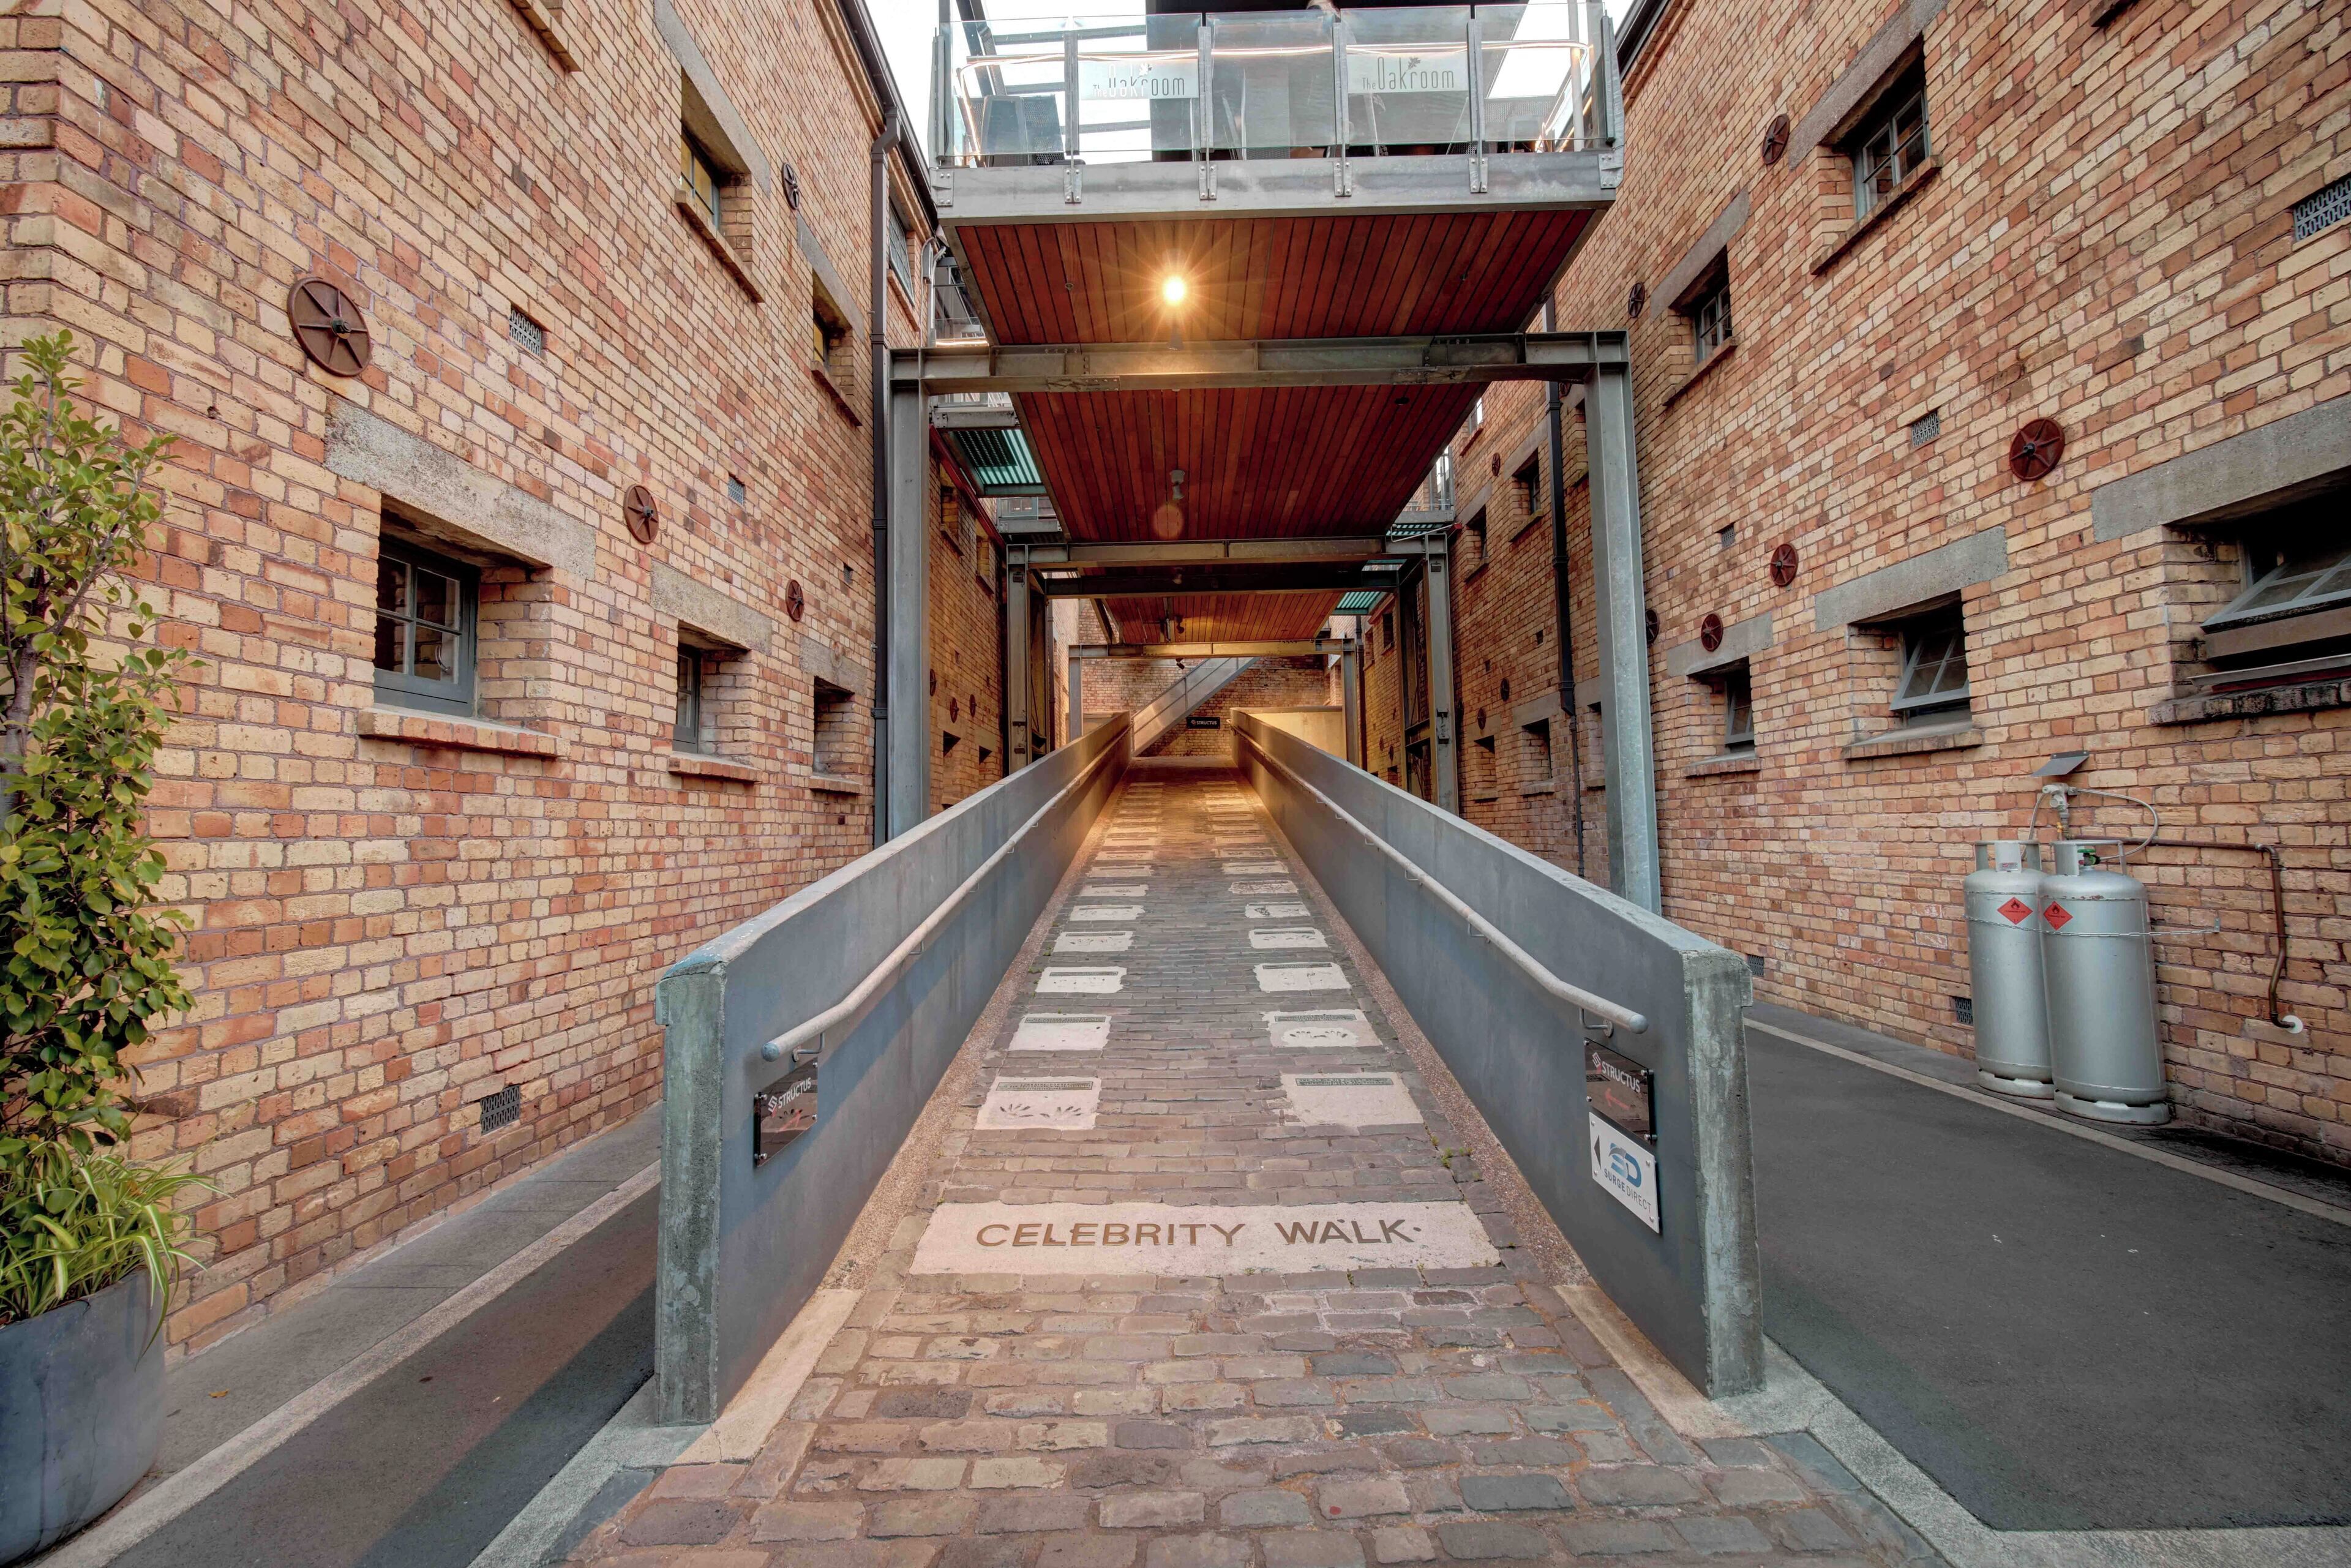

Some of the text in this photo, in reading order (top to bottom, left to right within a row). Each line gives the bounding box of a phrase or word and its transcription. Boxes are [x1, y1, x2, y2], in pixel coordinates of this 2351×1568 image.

[1109, 64, 1184, 97] Oakroom
[1362, 56, 1454, 90] The Oakroom
[778, 1077, 812, 1109] STRUCTUS
[1602, 1061, 1641, 1093] STRUCTUS
[977, 1219, 1415, 1247] CELEBRITY WALK
